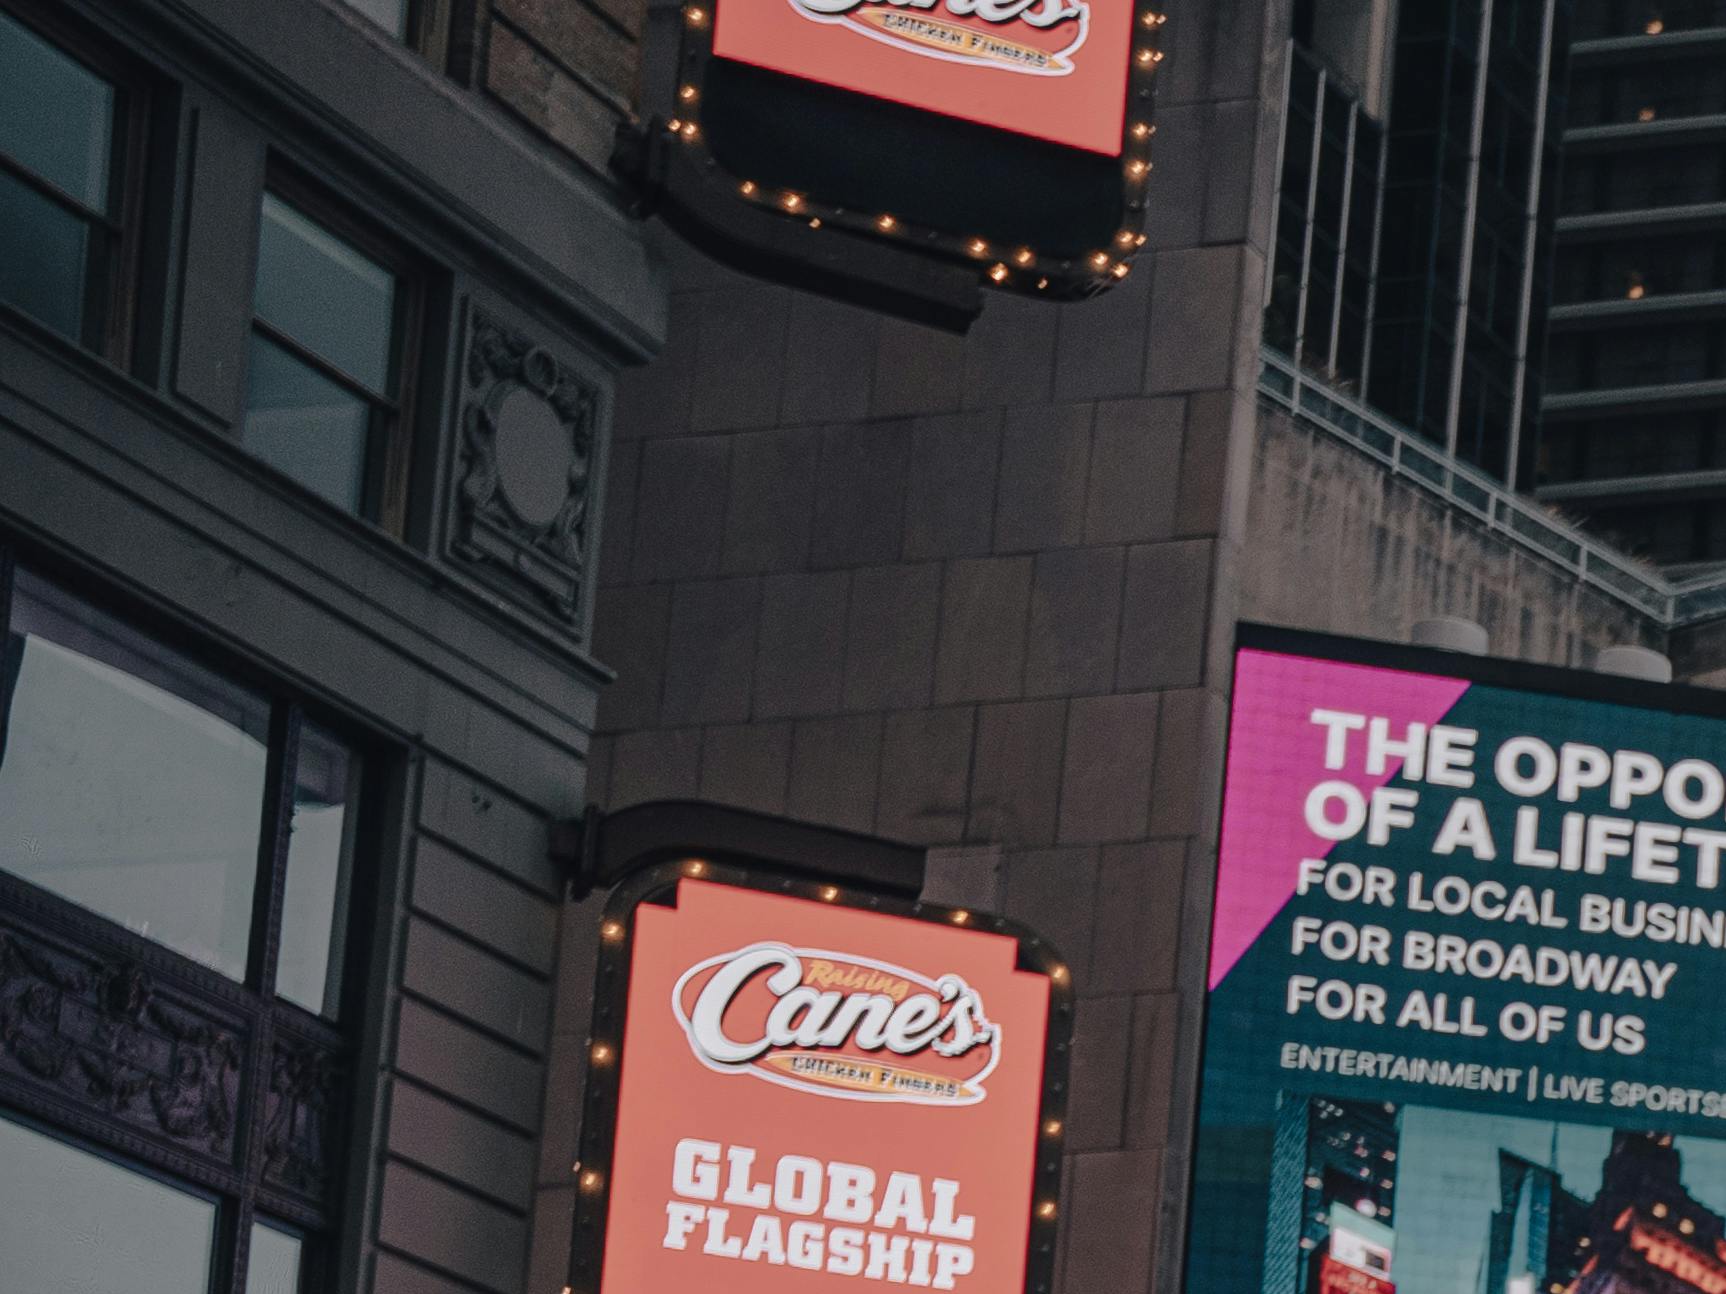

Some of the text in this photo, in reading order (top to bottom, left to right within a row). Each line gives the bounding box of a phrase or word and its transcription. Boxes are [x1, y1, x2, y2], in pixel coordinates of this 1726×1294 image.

[1309, 708, 1479, 790] THE
[1303, 779, 1420, 847] OF
[1431, 796, 1497, 862] A
[1296, 857, 1397, 908] FOR
[1407, 871, 1569, 930] LOCAL
[806, 959, 909, 1001] Raising
[1290, 915, 1679, 1000] FOR BROADWAY
[691, 948, 995, 1063] Cane's
[1285, 974, 1647, 1056] FOR ALL OF US
[1279, 1041, 1522, 1094] ENTERTAINMENT
[1543, 1073, 1605, 1104] LIVE
[672, 1137, 976, 1242] GLOBAL
[662, 1200, 975, 1291] FLAGSHIP
